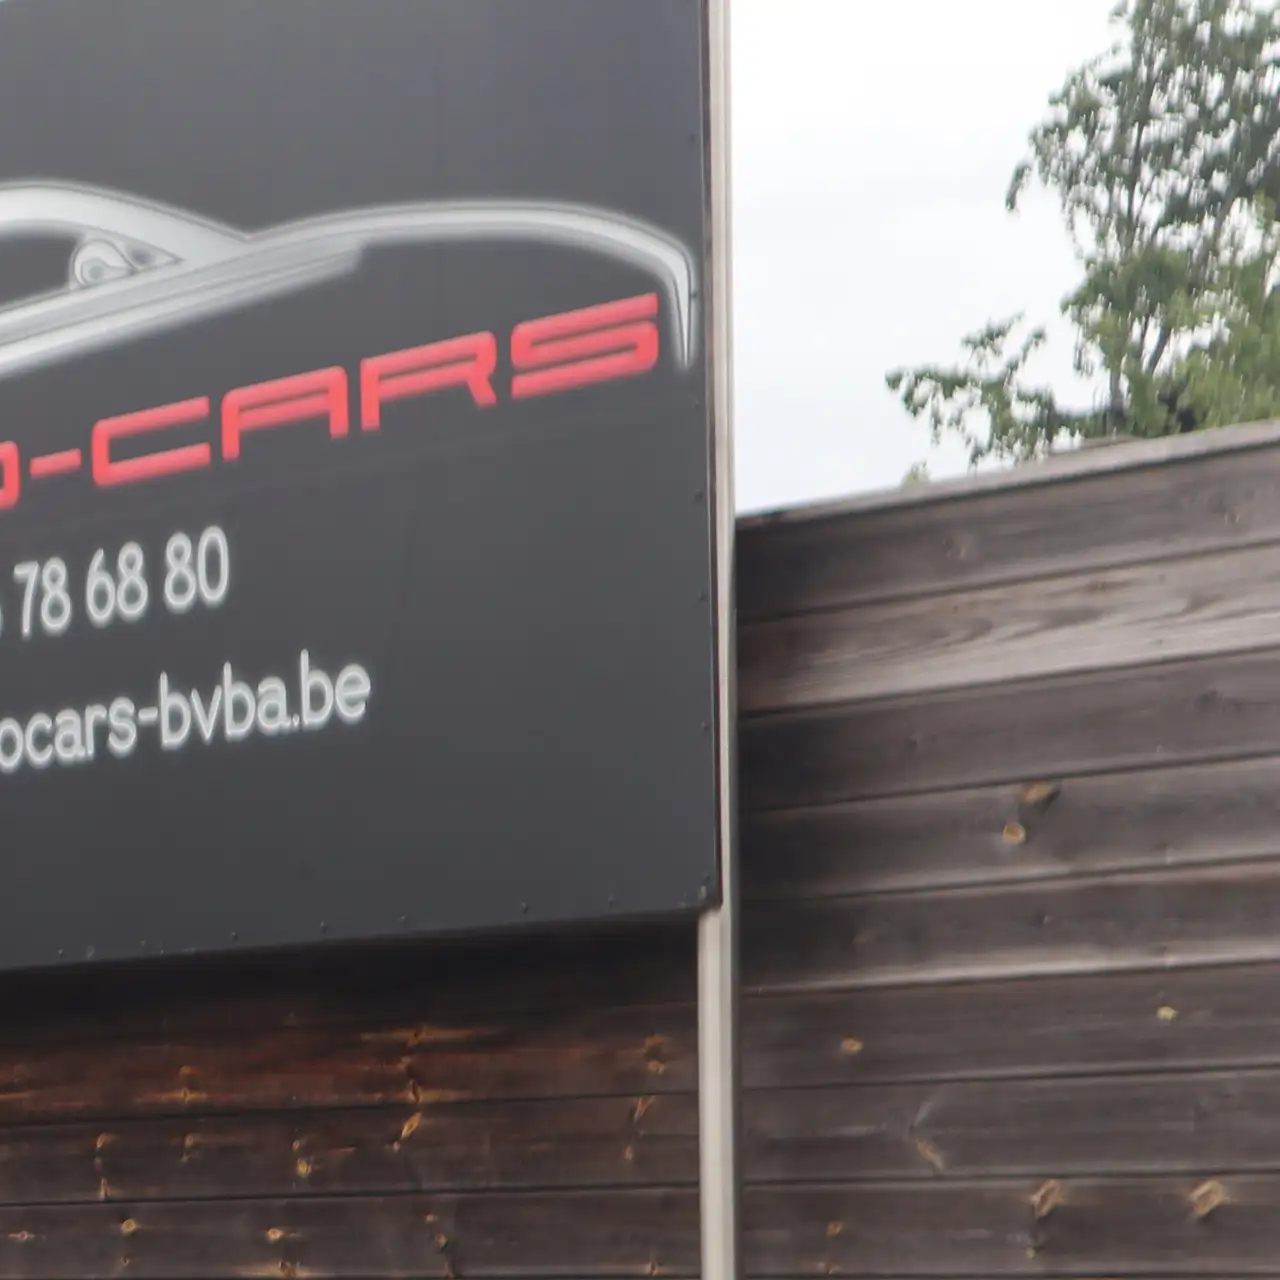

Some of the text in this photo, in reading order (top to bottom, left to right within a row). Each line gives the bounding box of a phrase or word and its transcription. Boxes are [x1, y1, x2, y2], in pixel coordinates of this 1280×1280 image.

[11, 555, 74, 639] 78
[83, 539, 151, 628] 68
[161, 523, 232, 614] 80
